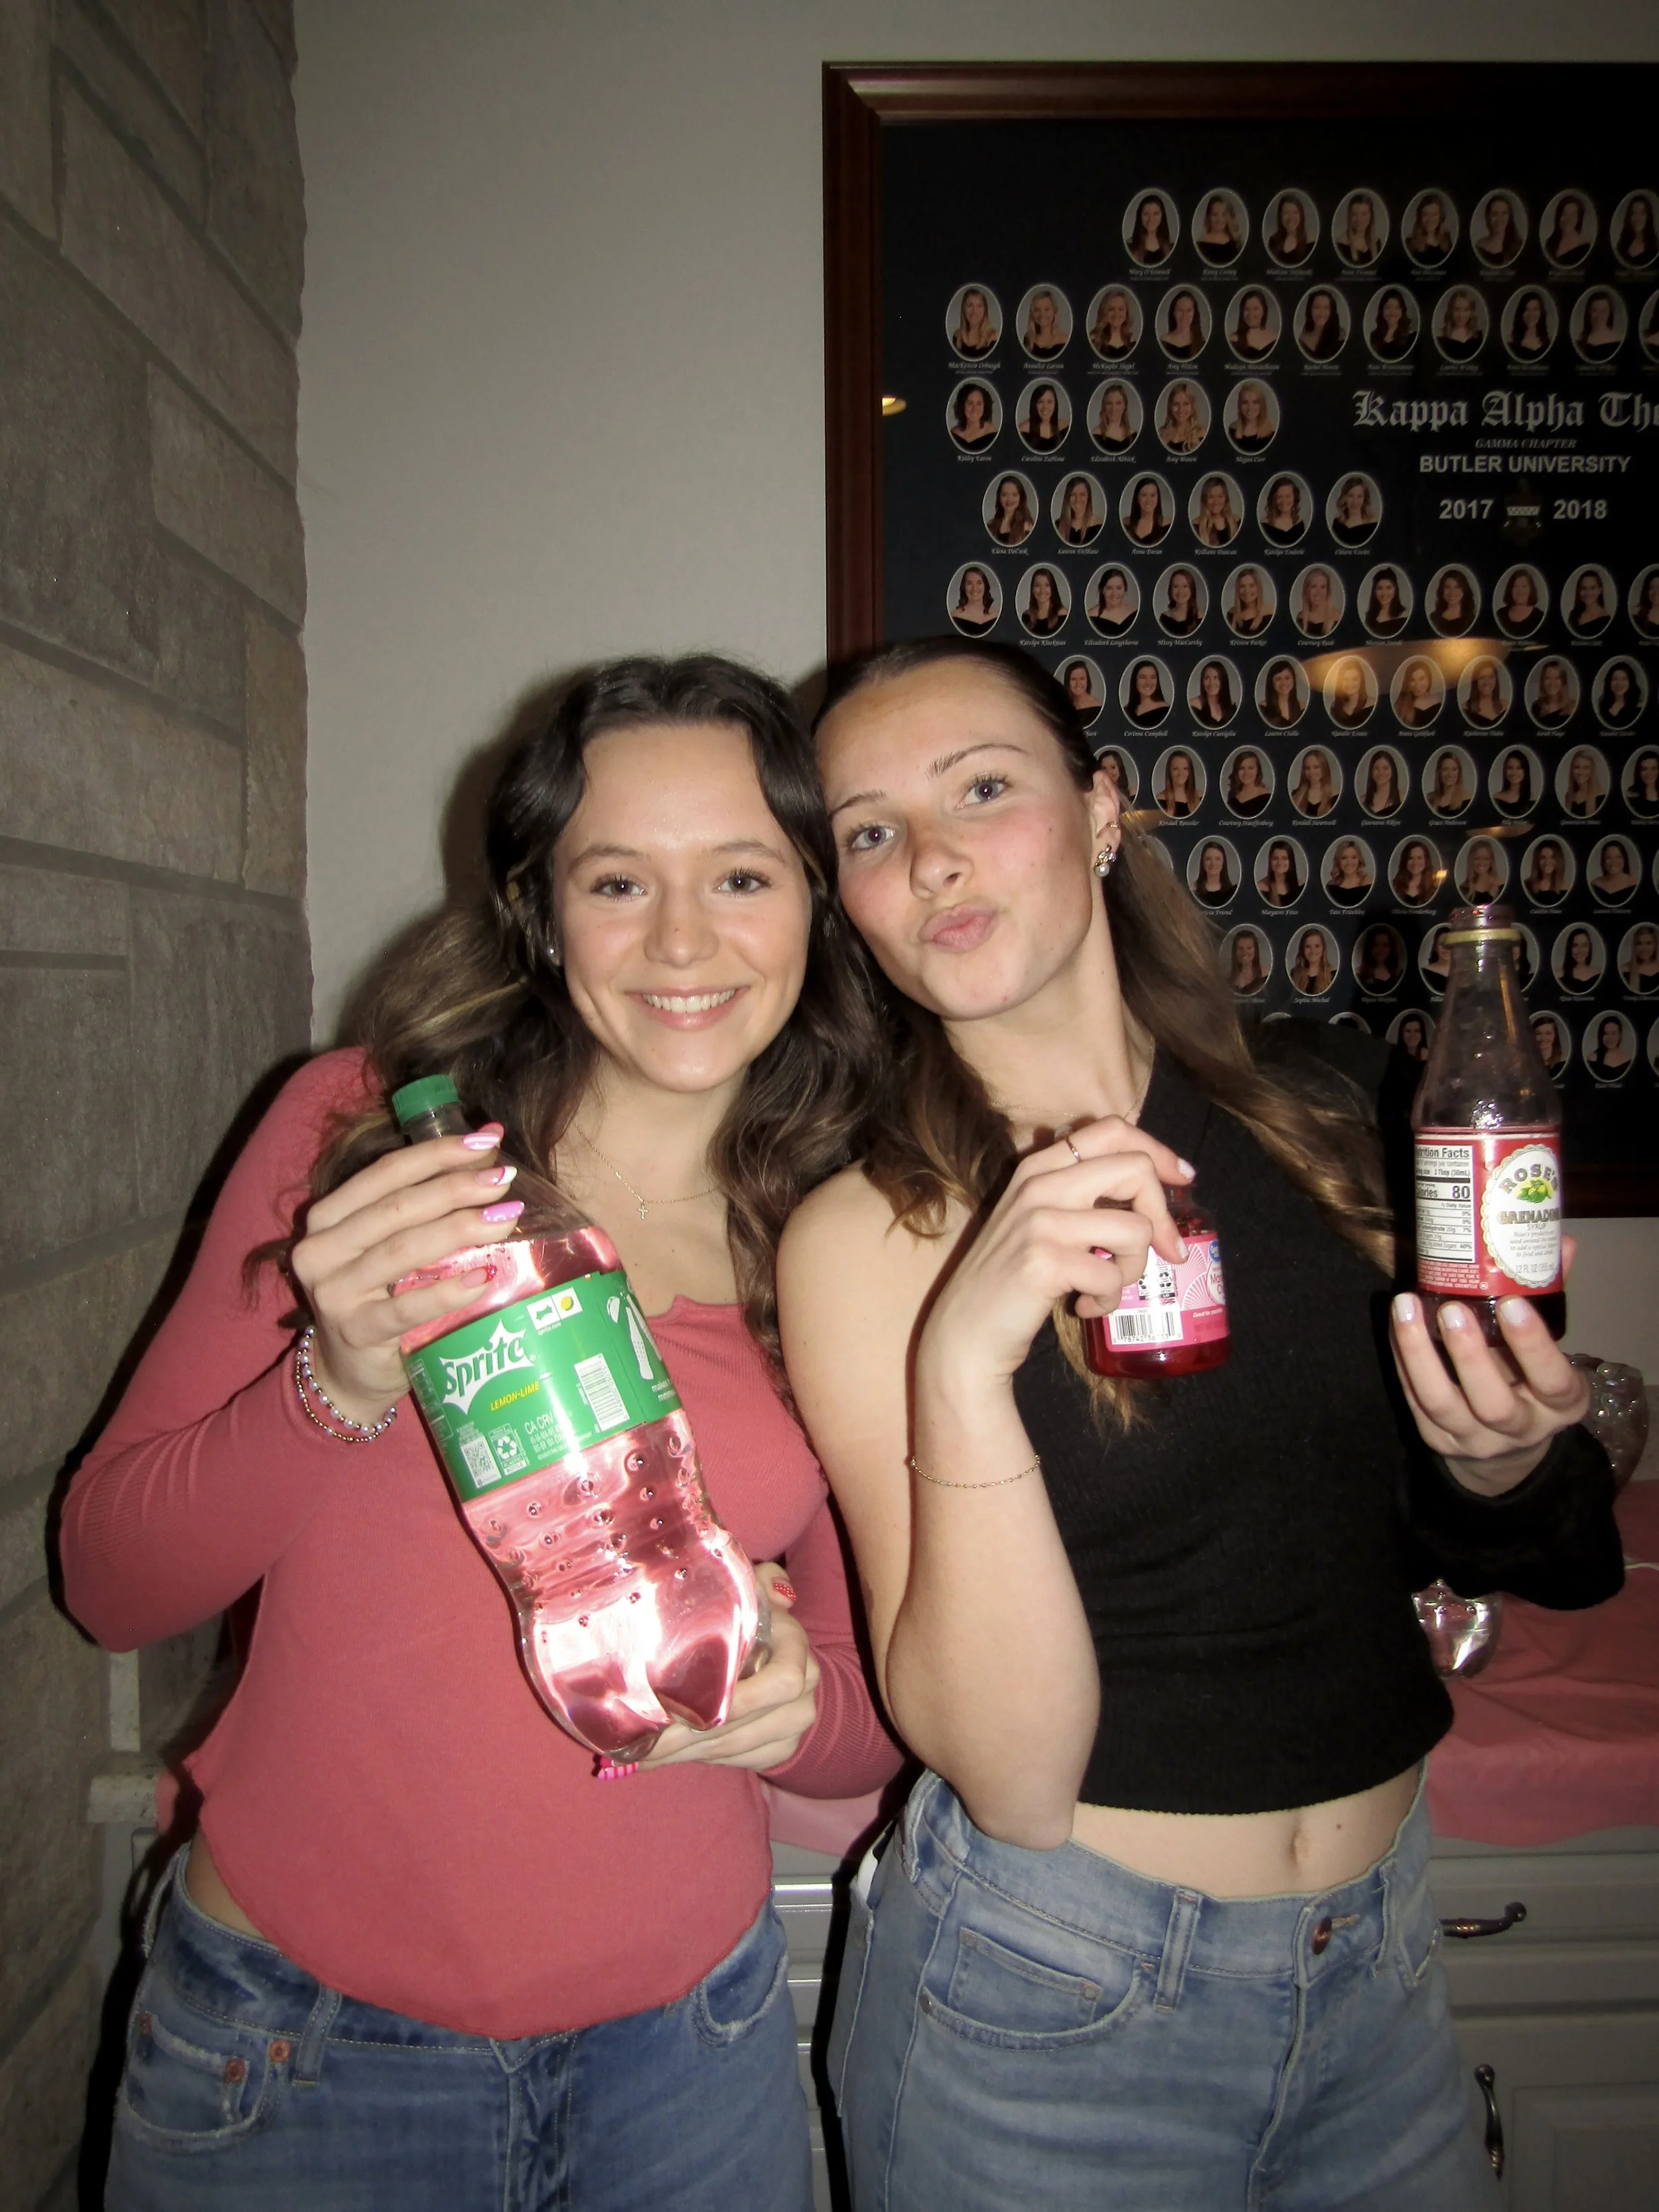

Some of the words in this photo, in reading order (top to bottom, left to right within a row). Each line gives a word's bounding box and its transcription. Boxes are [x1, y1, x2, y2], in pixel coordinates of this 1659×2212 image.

[1352, 390, 1469, 433] Kappa
[1481, 390, 1585, 433] Alpha
[1475, 438, 1518, 449] GAMMA
[1520, 438, 1578, 449] CHAPTER
[1419, 455, 1502, 473] BUTLER
[1508, 455, 1631, 473] UNIVERSITY
[1439, 498, 1493, 520] 2017
[1553, 498, 1608, 520] 2018
[1442, 1147, 1470, 1158] Facts
[1451, 1185, 1471, 1199] 80
[1527, 1222, 1546, 1231] SYRUP
[537, 1321, 563, 1336] sprite.com
[443, 1335, 526, 1398] Sprite
[524, 1420, 538, 1436] CA
[536, 1412, 555, 1430] CRV
[506, 1462, 524, 1473] BOTTLE
